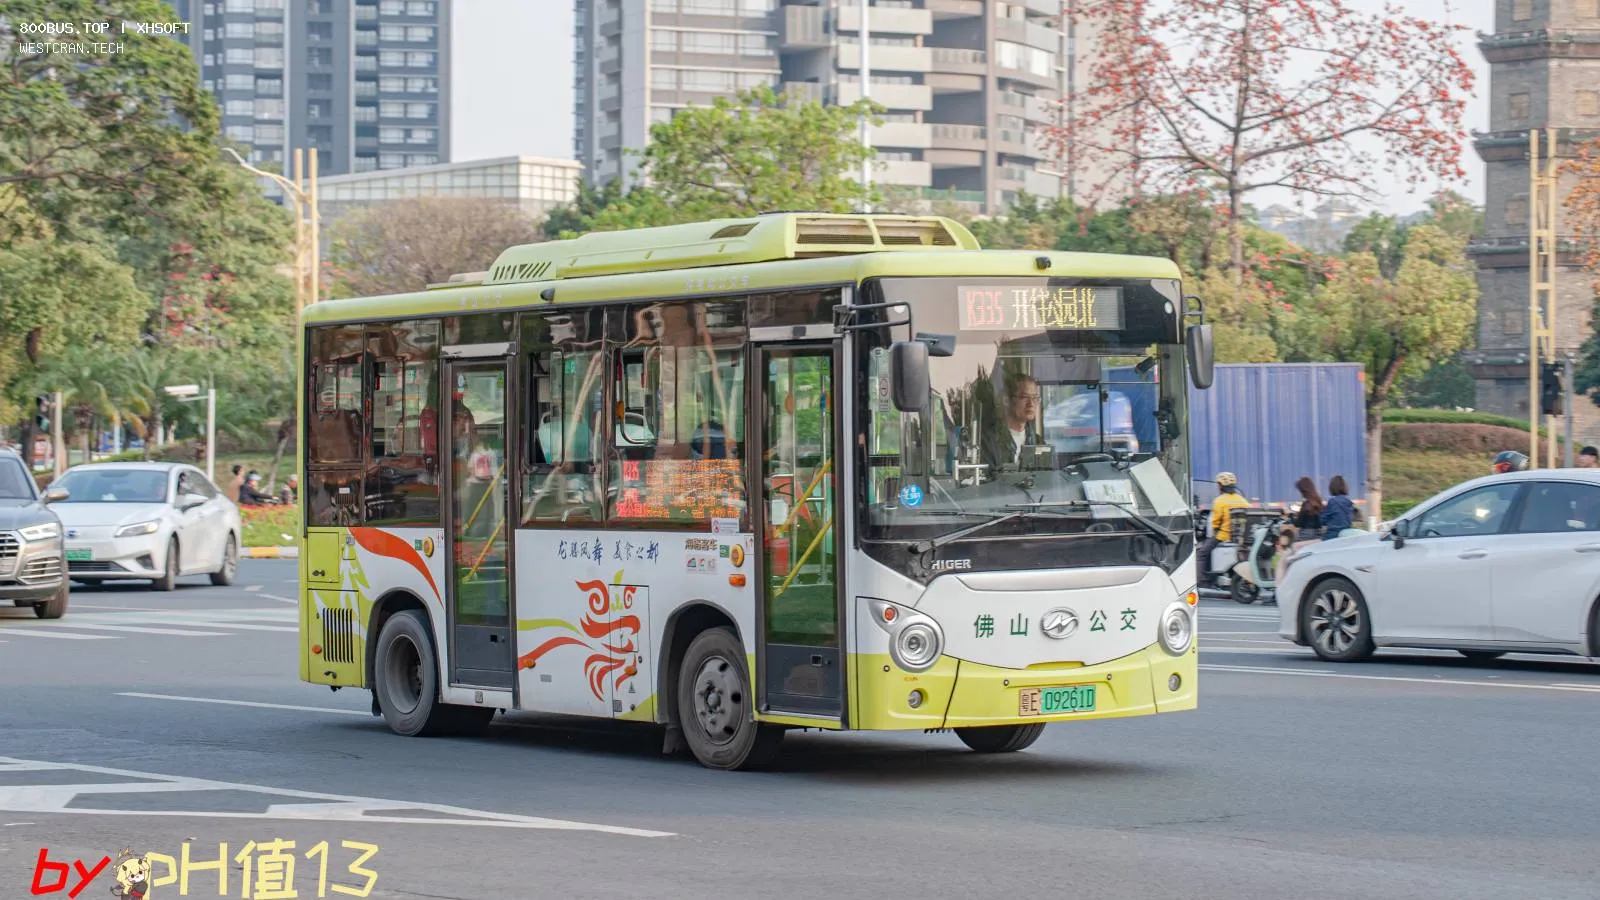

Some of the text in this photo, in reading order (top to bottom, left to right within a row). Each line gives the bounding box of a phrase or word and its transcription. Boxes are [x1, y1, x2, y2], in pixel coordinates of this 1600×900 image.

[966, 290, 1005, 327] K335
[931, 558, 972, 570] HIGER
[973, 607, 1138, 639] 佛山 公交
